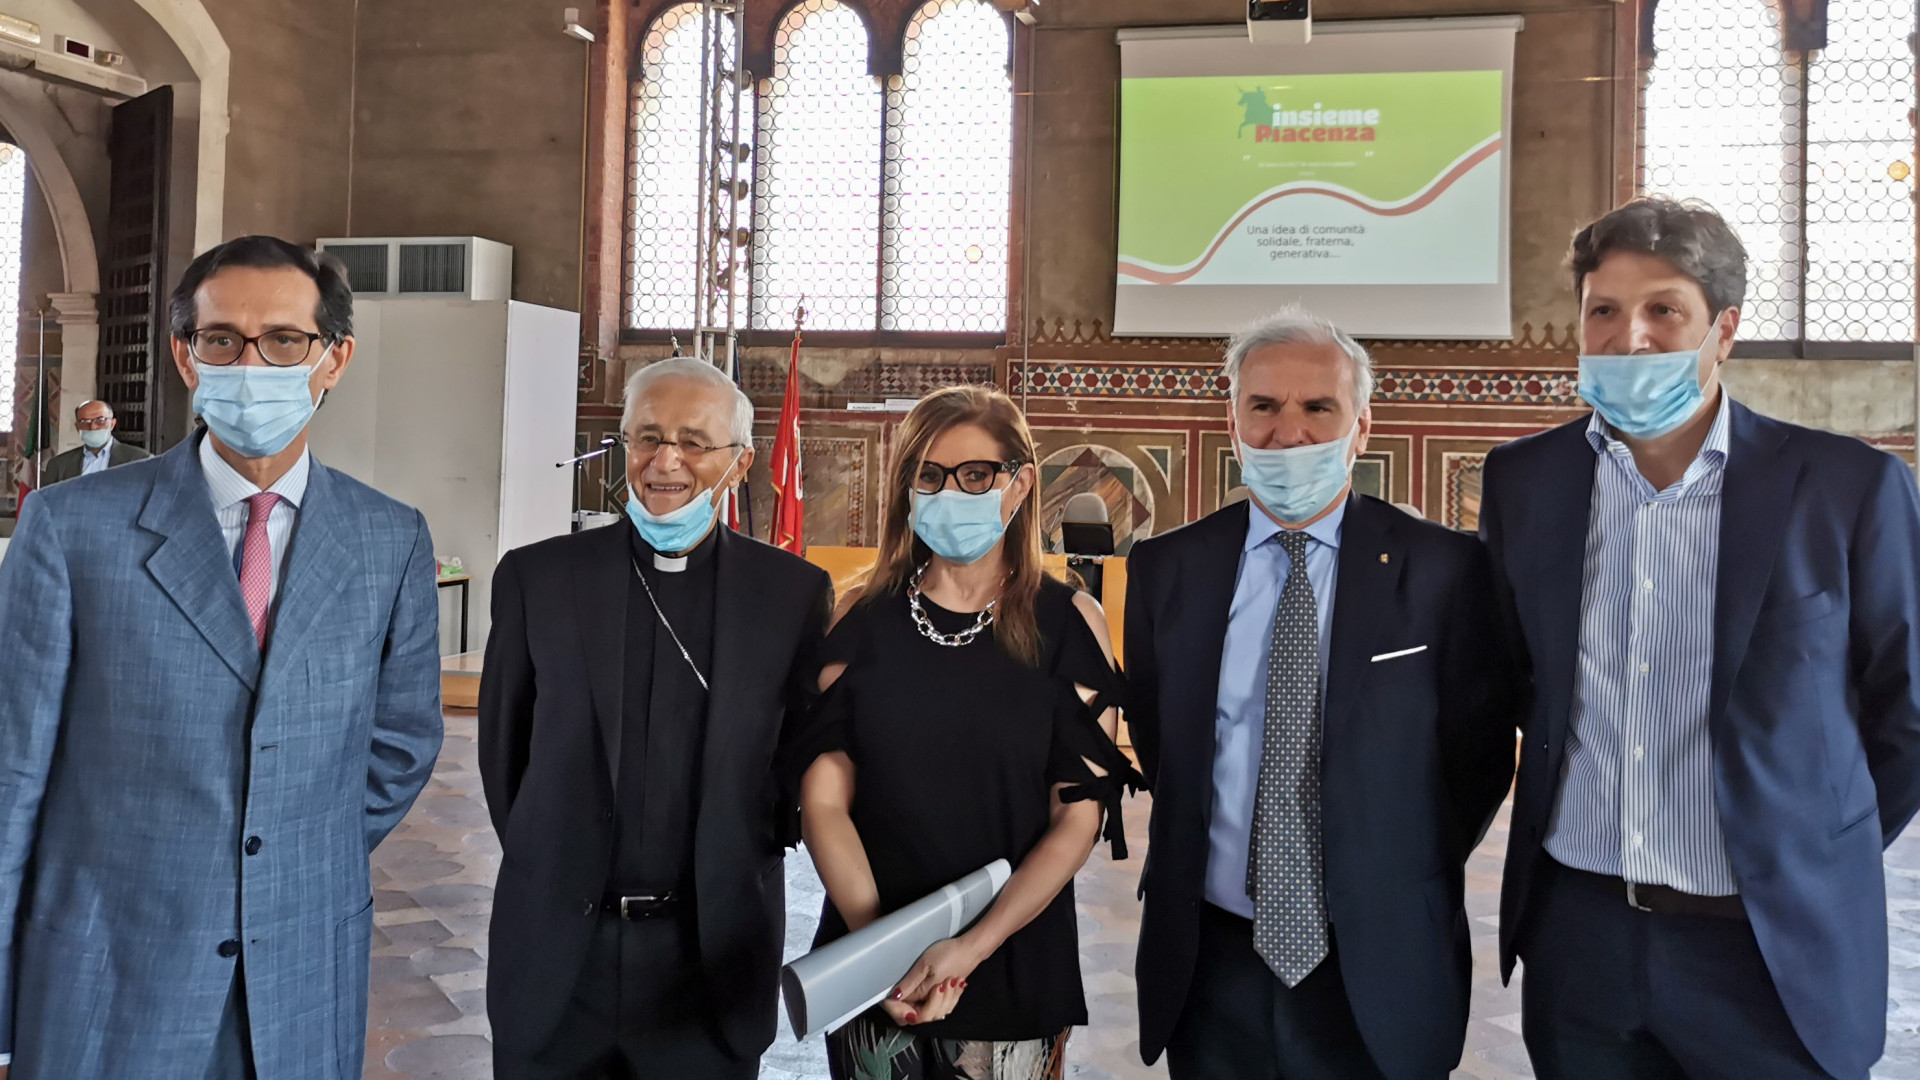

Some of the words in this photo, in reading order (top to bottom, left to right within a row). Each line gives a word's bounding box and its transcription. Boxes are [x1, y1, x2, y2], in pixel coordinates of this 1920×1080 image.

[1272, 102, 1380, 127] insieme
[1255, 125, 1376, 143] Piacenza
[1246, 225, 1269, 235] Una
[1272, 224, 1296, 234] idea
[1298, 224, 1310, 234] di
[1312, 224, 1366, 234] comunità
[1256, 236, 1303, 247] solidale,
[1305, 236, 1355, 247] fraterna,
